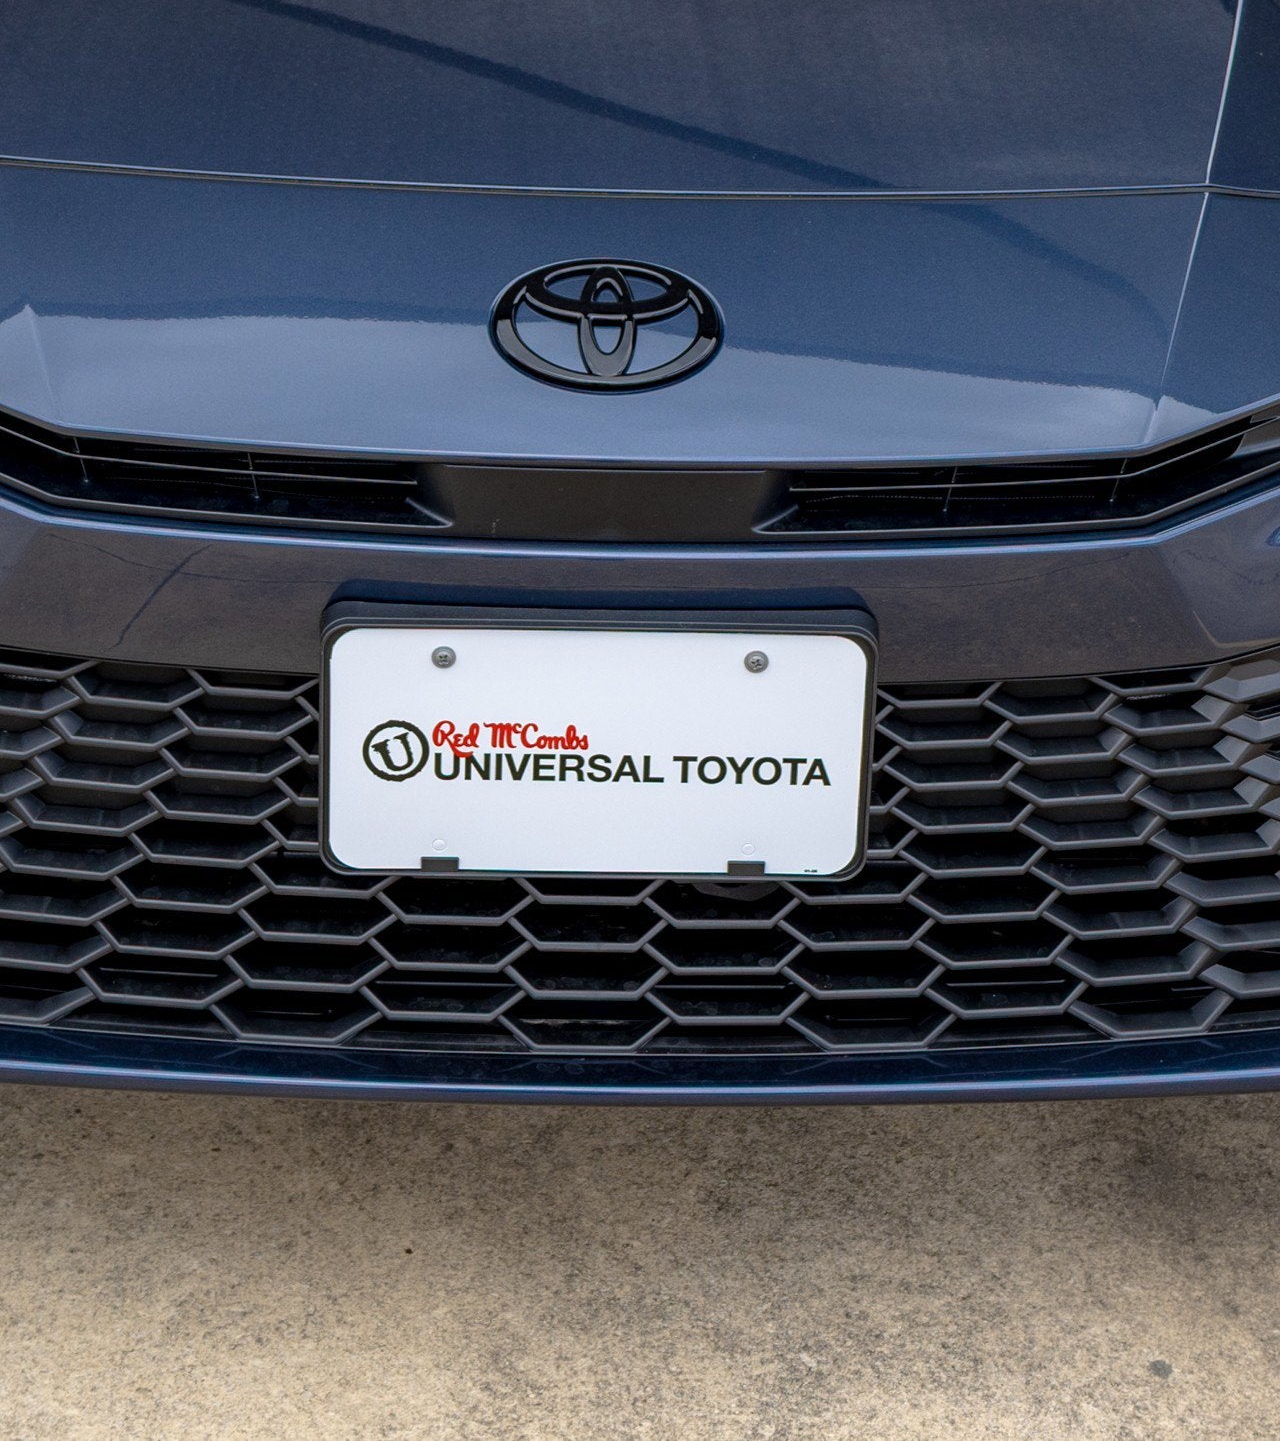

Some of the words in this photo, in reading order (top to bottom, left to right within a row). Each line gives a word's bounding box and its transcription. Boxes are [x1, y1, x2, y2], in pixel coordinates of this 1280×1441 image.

[432, 720, 480, 758] Red
[483, 721, 589, 750] McCombs
[433, 752, 665, 784] UNIVERSAL
[673, 755, 832, 787] TOYOTA
